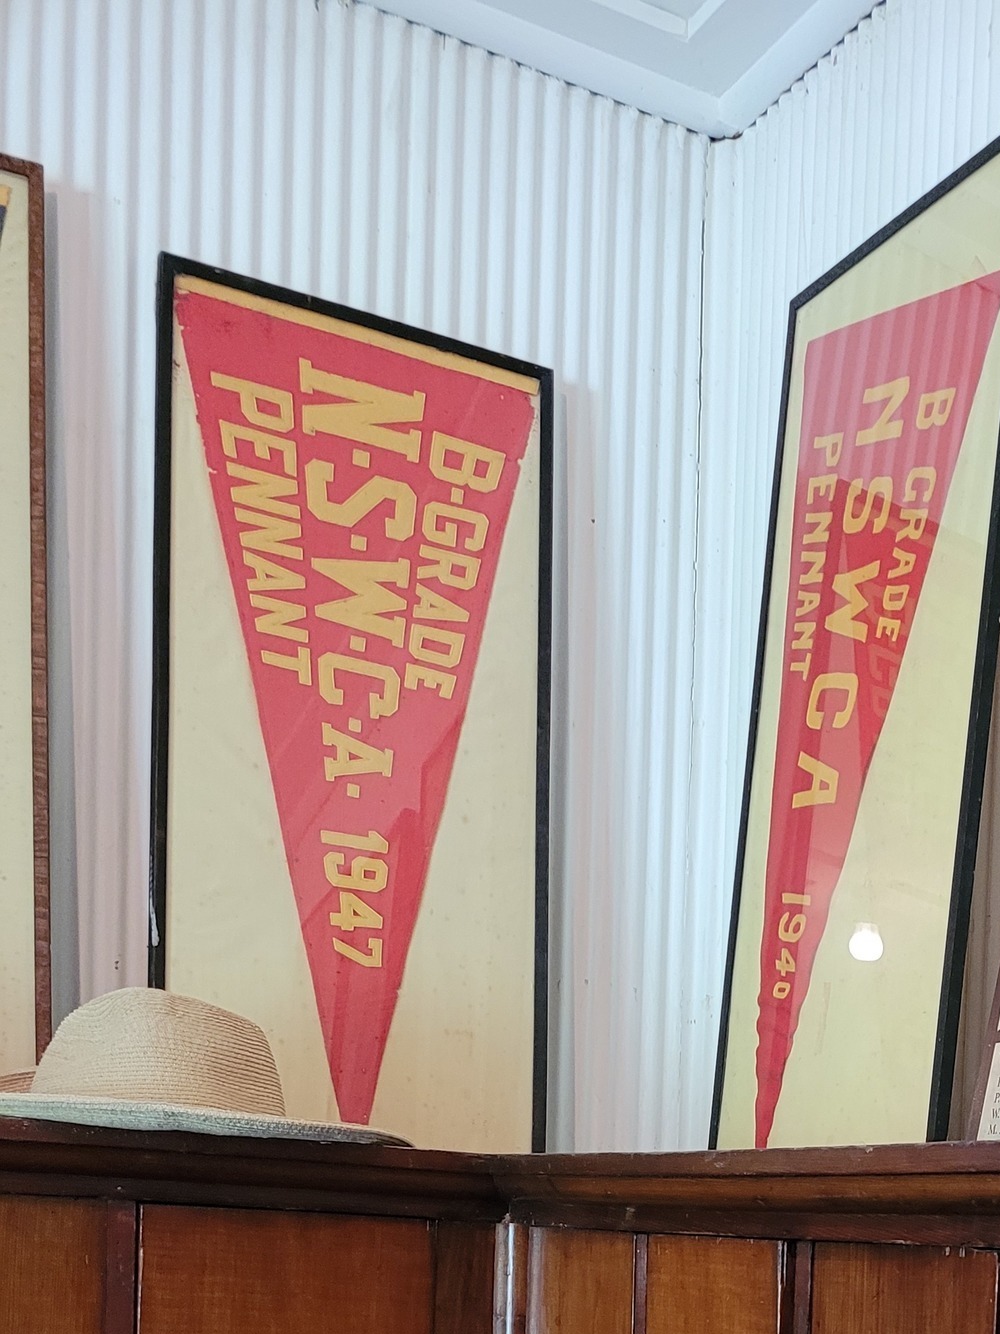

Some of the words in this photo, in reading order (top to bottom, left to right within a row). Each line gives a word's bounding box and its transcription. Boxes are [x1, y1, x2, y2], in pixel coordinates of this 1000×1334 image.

[915, 387, 956, 430] B
[210, 370, 312, 686] PENNANT
[789, 431, 844, 682] PENNANT
[875, 465, 937, 642] GRADE
[320, 829, 390, 968] 1947
[772, 892, 811, 1000] 1940
[992, 1107, 1000, 1119] W.
[994, 1092, 1000, 1103] P.
